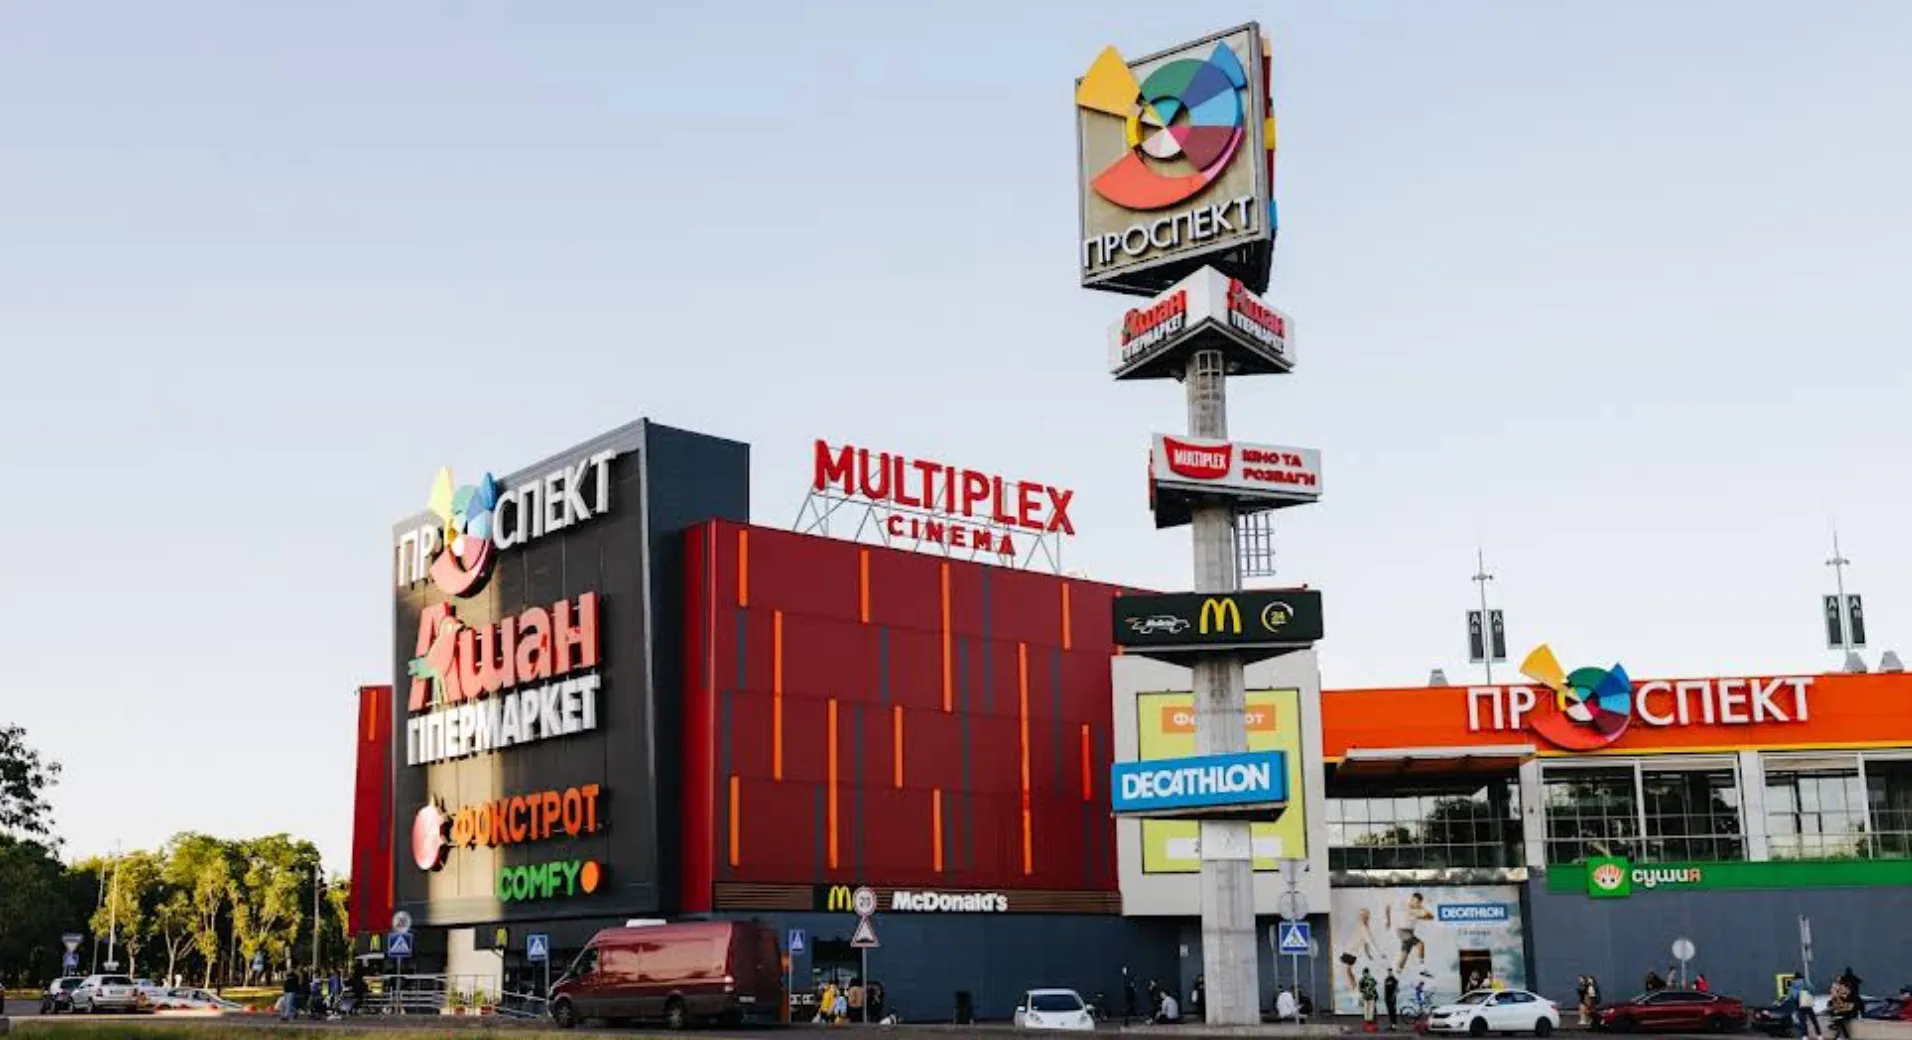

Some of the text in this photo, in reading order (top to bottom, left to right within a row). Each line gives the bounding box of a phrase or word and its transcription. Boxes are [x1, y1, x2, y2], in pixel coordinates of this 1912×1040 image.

[1084, 197, 1254, 269] ПРОСПЕКТ
[1174, 449, 1226, 469] MULTIPLEX
[1242, 449, 1302, 467] КІНО ТА
[1243, 468, 1316, 486] РОЗВАГИ
[815, 438, 1075, 535] MULTIPLEX
[887, 515, 1016, 556] CINEMA
[408, 591, 600, 712] Ашан
[407, 674, 601, 766] ГІПЕРМАРКЕТ
[1121, 762, 1270, 800] DECATHLON
[452, 784, 600, 849] ФОКСТРОТ
[499, 860, 580, 902] COMFY
[1632, 868, 1701, 888] сушия
[892, 890, 1008, 912] McDonald's
